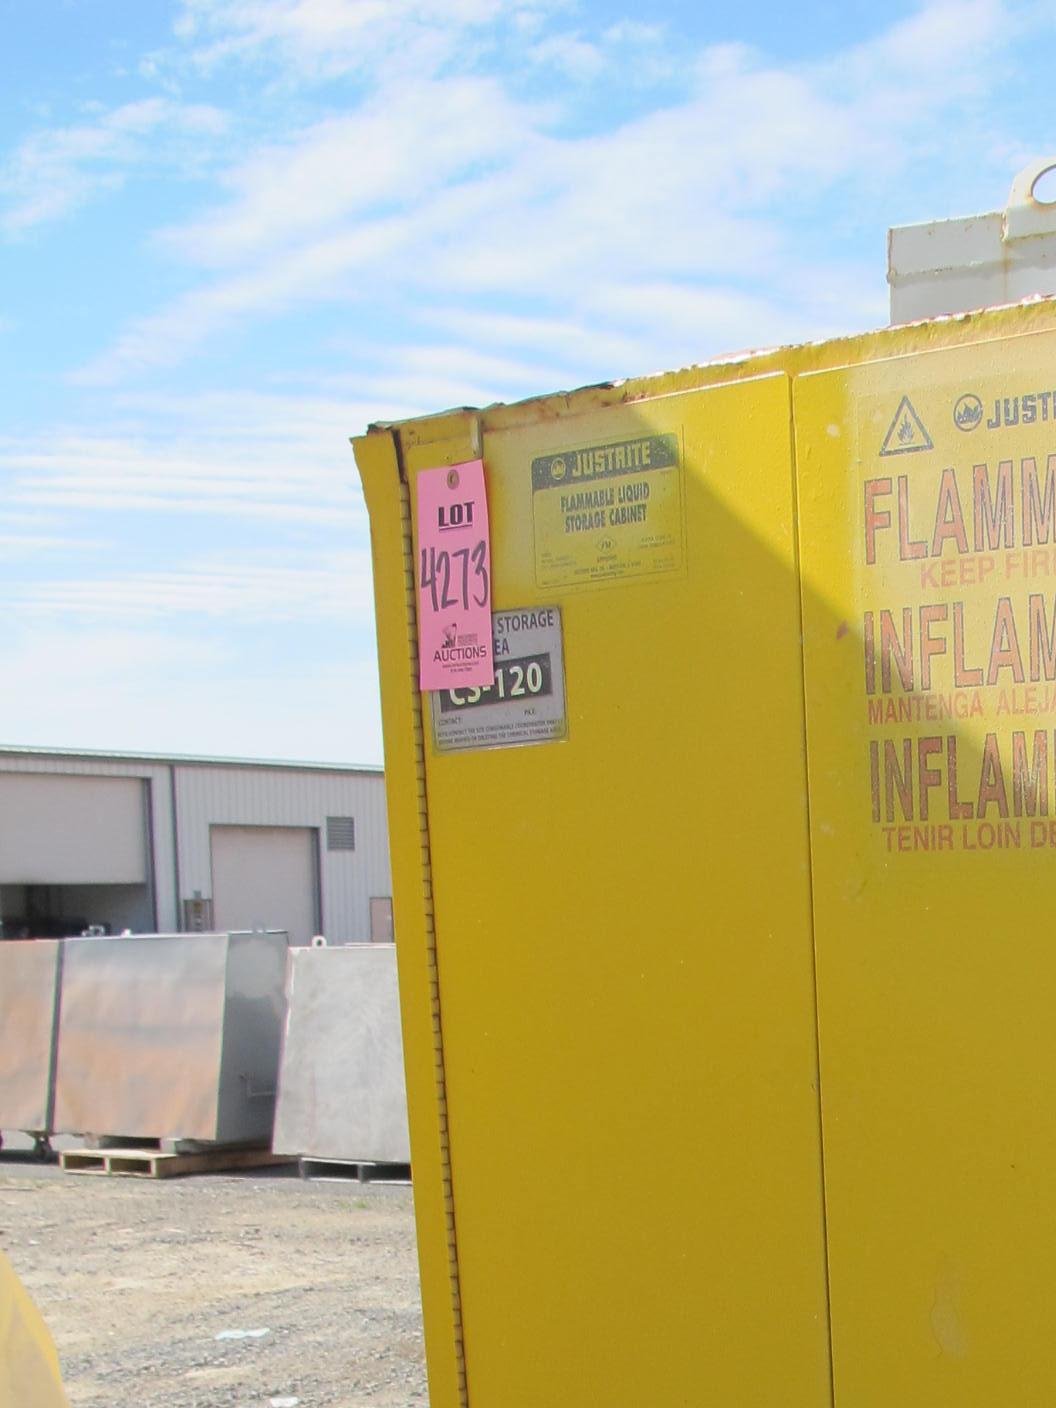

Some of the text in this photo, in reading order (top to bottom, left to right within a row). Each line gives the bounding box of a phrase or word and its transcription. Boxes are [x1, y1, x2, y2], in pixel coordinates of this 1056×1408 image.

[572, 441, 651, 477] JUSTRITE
[559, 482, 650, 513] FLAMMABLE LIQUID
[438, 502, 475, 528] LOT
[564, 504, 647, 533] STORAGE CABINET
[420, 540, 488, 612] 4273
[919, 556, 994, 590] KEEP
[497, 609, 554, 634] STORAGE
[433, 645, 487, 662] AUCTIONS
[867, 696, 984, 725] MANTENGA
[882, 823, 954, 854] TENIR
[962, 821, 1022, 851] LOIN
